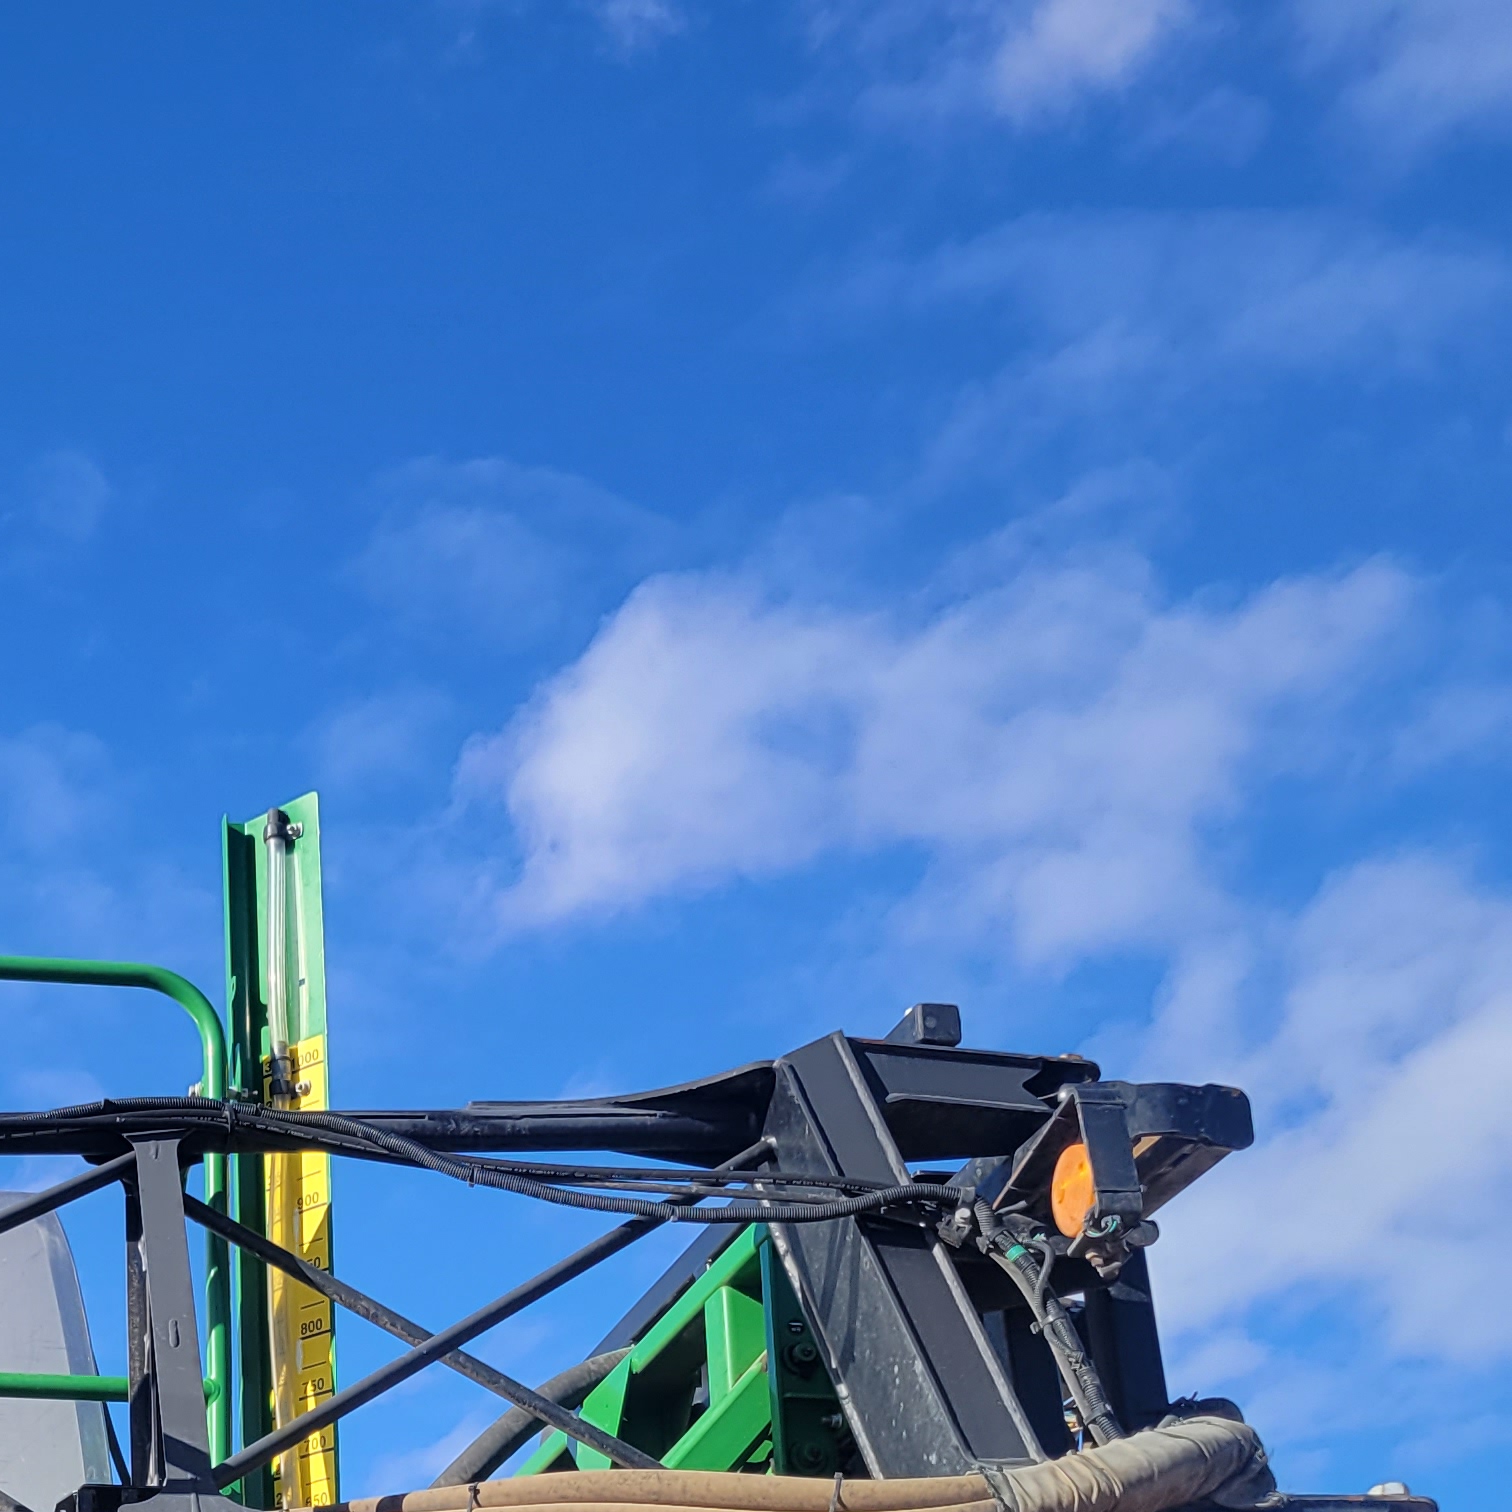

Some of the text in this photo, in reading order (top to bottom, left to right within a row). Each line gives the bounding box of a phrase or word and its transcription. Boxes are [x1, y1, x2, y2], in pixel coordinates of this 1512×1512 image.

[290, 1048, 320, 1072] 1000
[297, 1191, 319, 1210] 900
[300, 1318, 323, 1336] 800
[301, 1377, 325, 1391] 750
[303, 1435, 327, 1453] 700
